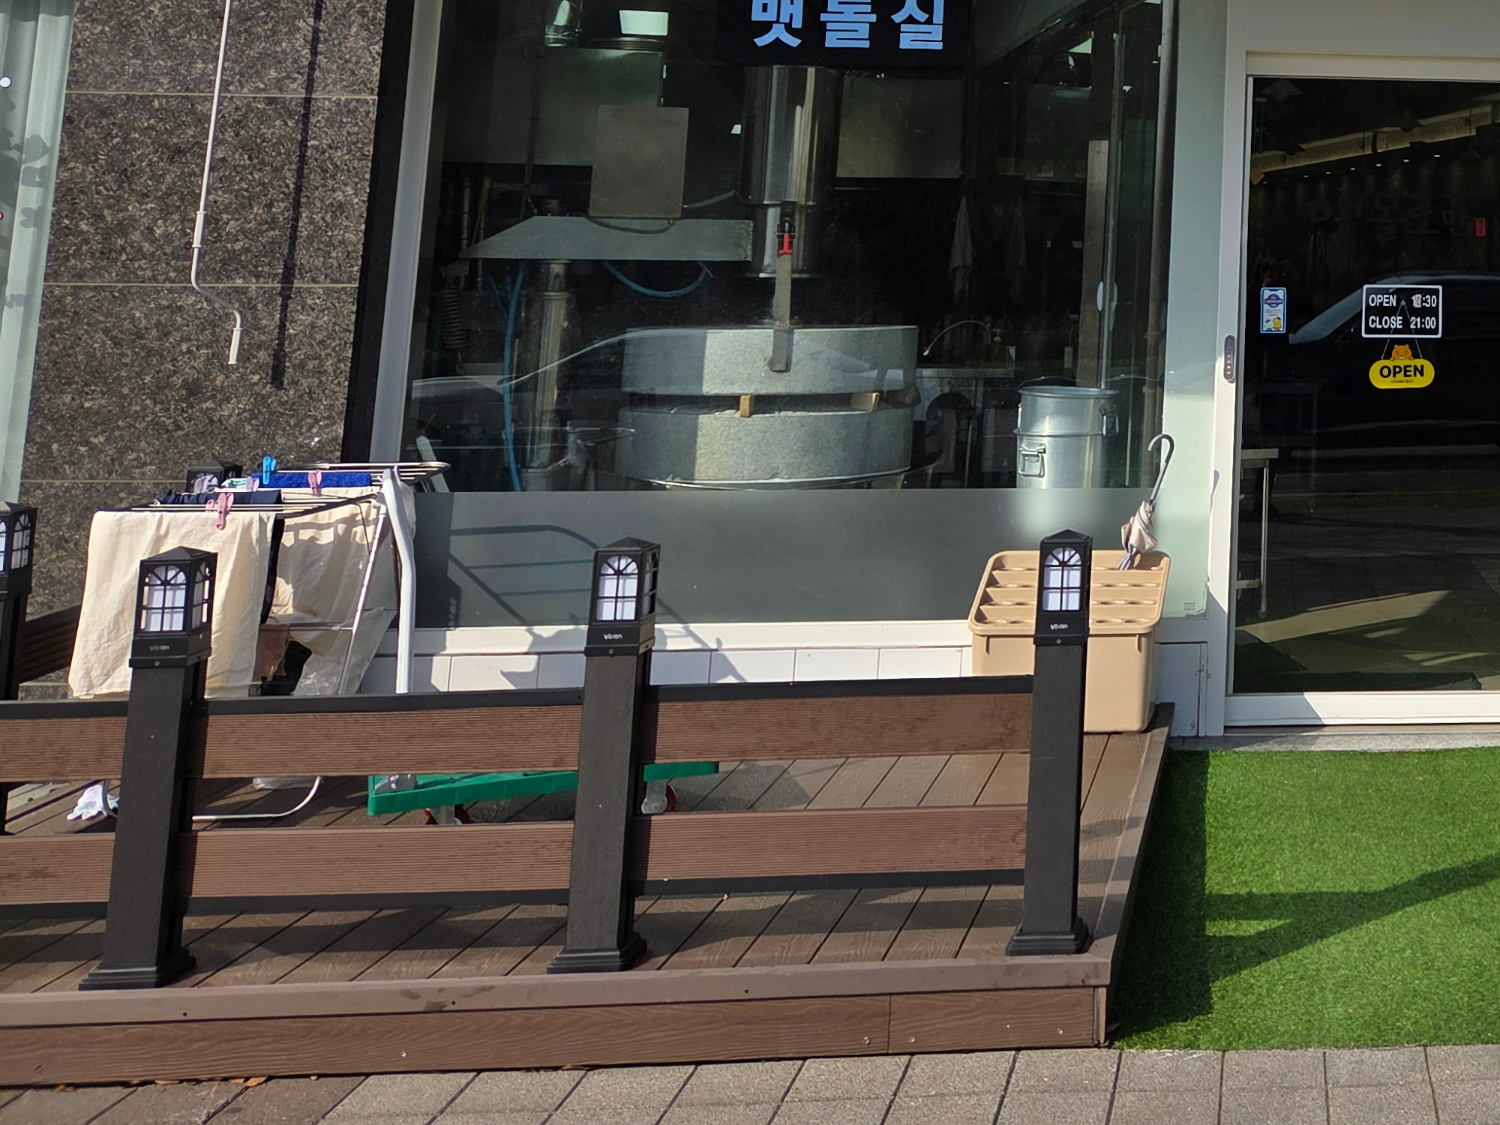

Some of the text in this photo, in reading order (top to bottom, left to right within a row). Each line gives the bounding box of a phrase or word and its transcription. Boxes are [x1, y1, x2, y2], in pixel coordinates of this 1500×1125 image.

[1368, 294, 1398, 307] OPEN
[1368, 315, 1437, 329] CLOSE 21:00
[1379, 364, 1425, 379] OPEN
